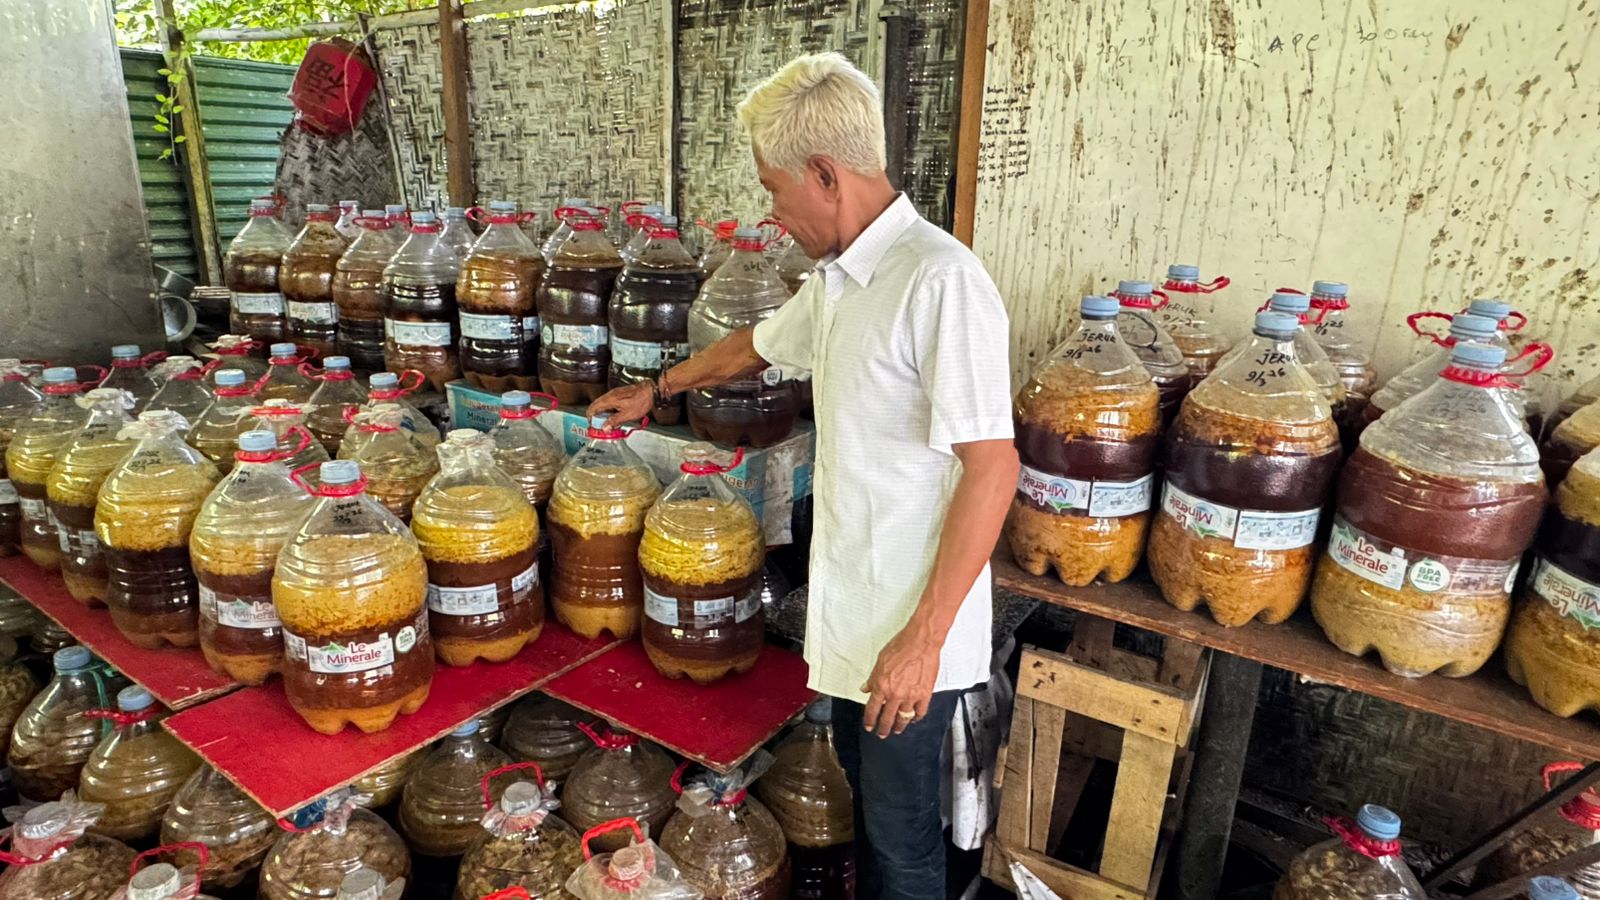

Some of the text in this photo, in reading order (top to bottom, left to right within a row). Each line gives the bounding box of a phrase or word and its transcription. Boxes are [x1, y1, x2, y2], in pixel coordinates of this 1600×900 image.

[1031, 489, 1044, 505] Le
[1358, 538, 1375, 557] Le
[1337, 540, 1389, 574] Minerale
[1416, 573, 1441, 583] FREE
[1418, 566, 1442, 577] BPA
[255, 602, 271, 612] Le
[350, 642, 366, 654] Le
[326, 650, 382, 665] Minerale
